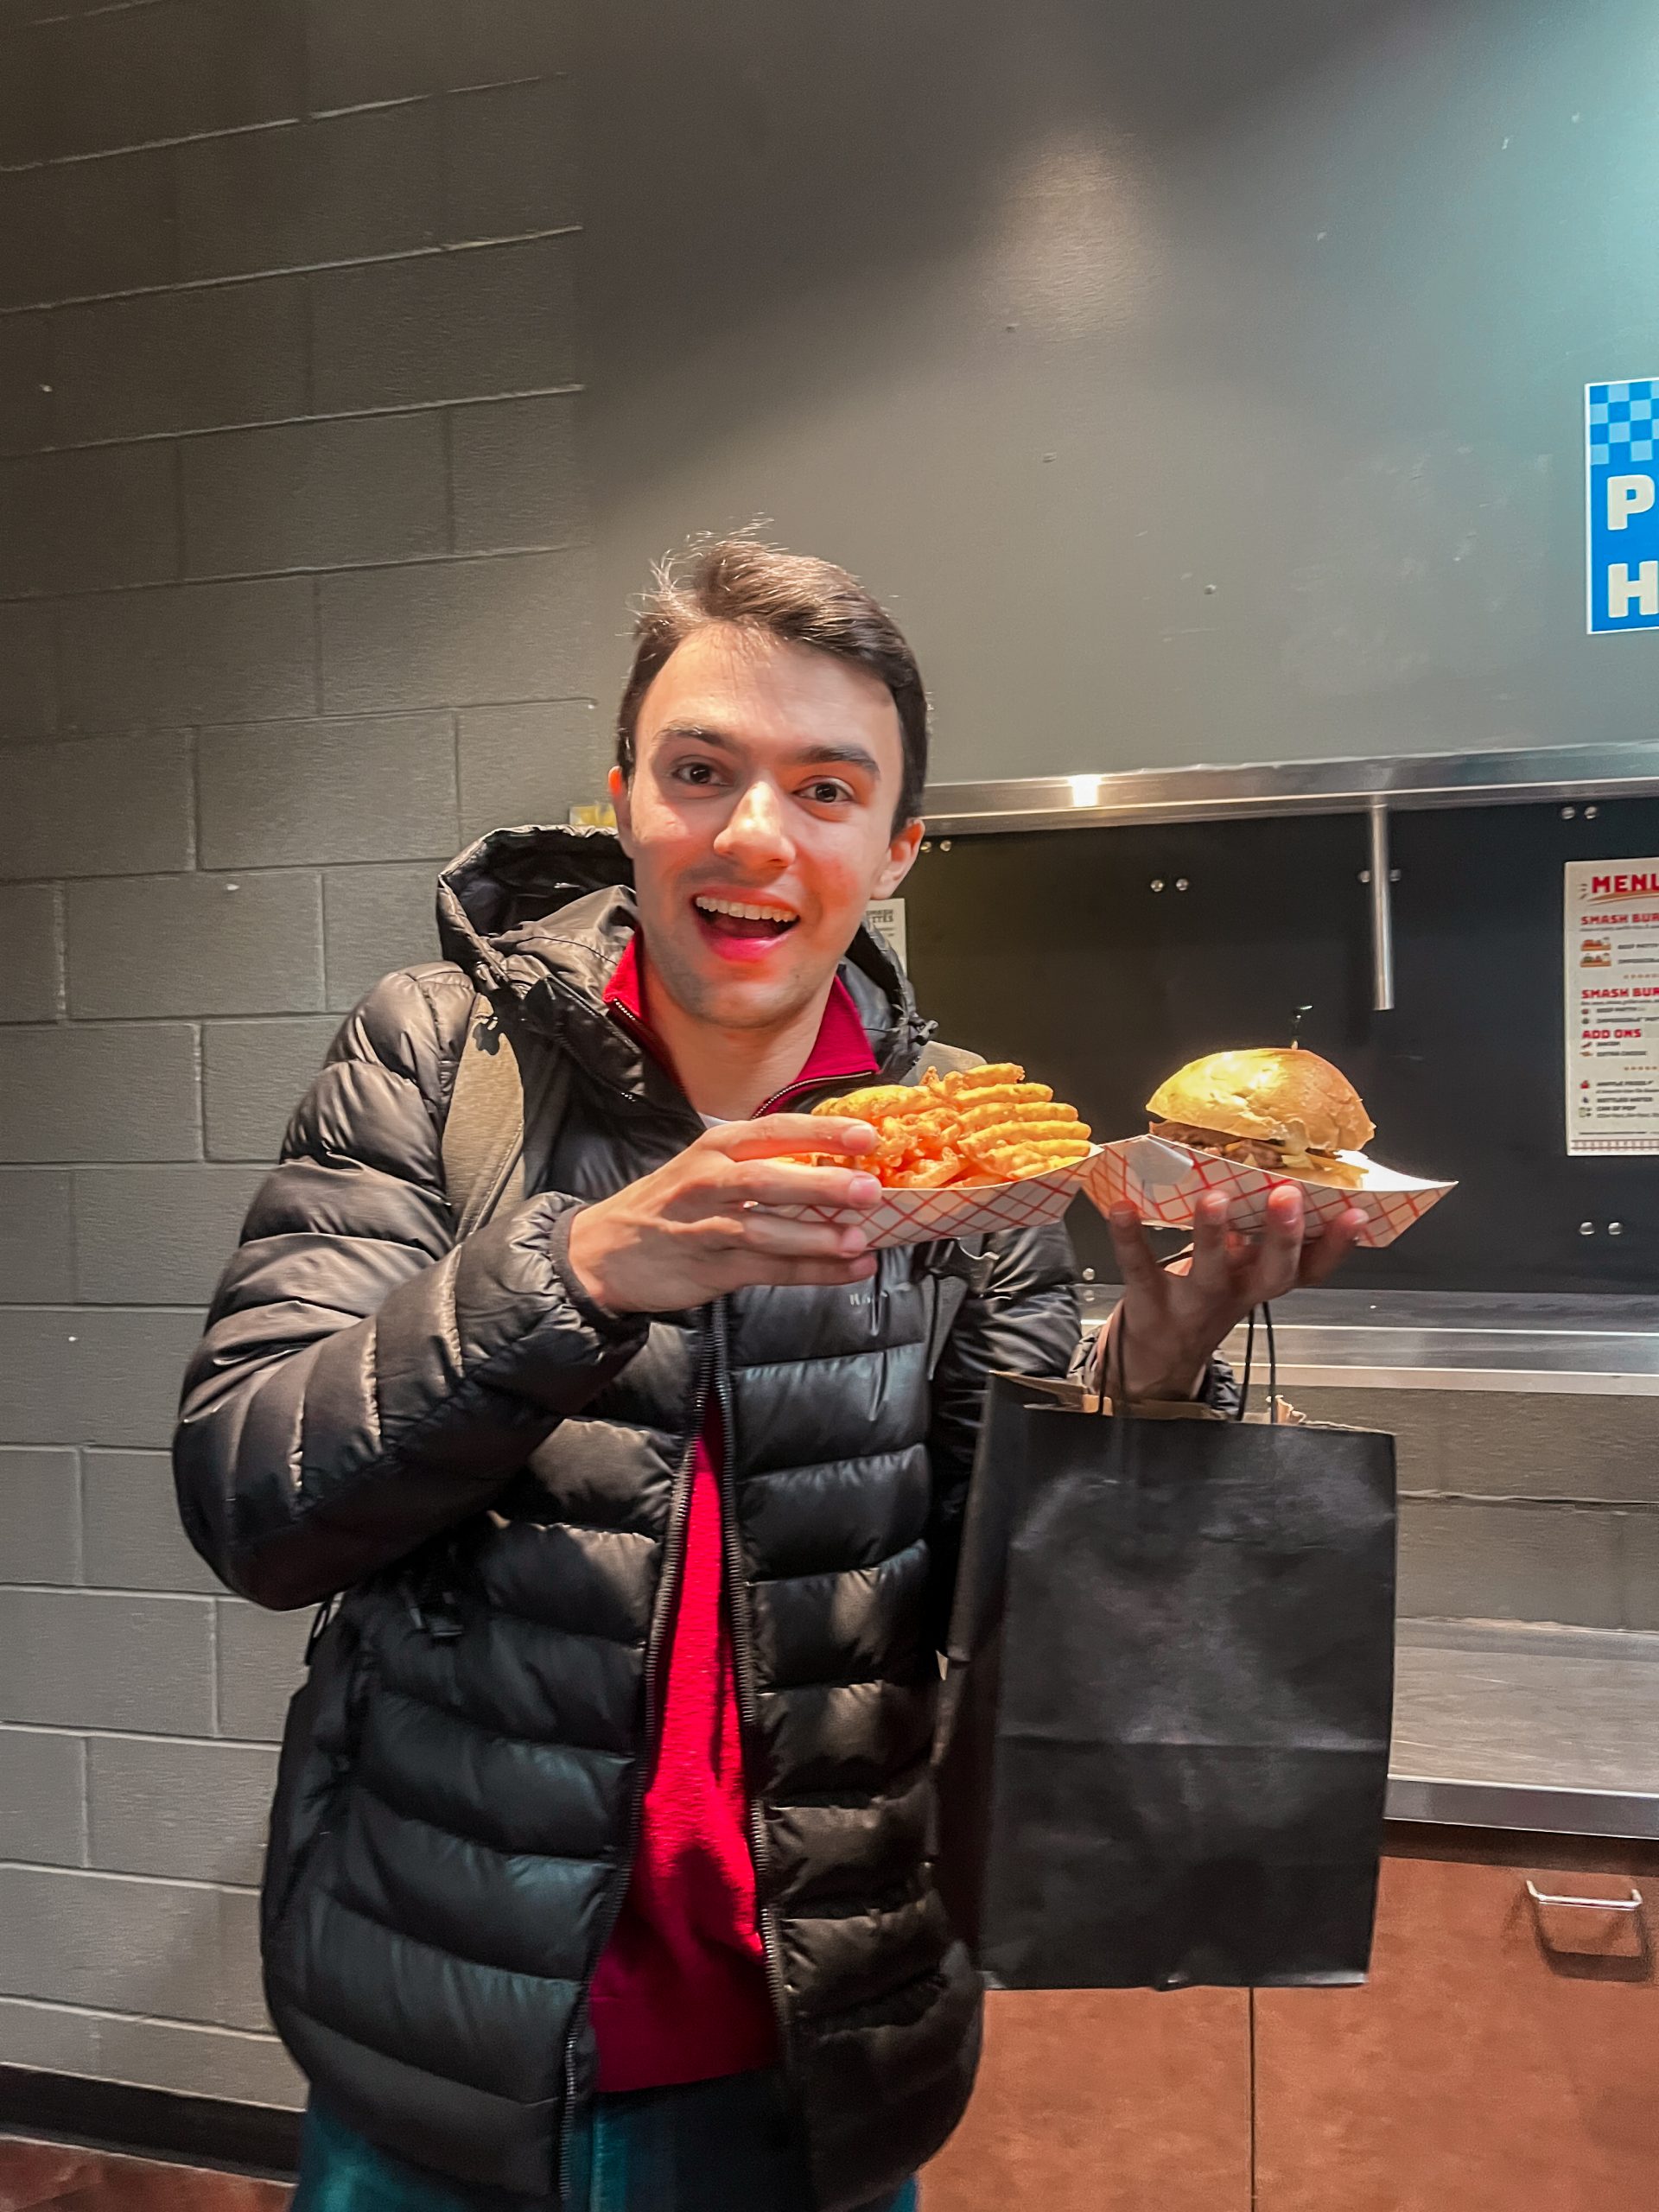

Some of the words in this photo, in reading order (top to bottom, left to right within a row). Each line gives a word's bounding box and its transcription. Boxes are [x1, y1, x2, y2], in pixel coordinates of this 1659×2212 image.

[1581, 915, 1628, 925] SMASH
[1581, 988, 1628, 998] SMASH
[1582, 1030, 1610, 1039] ADD
[1615, 1029, 1641, 1038] ONS
